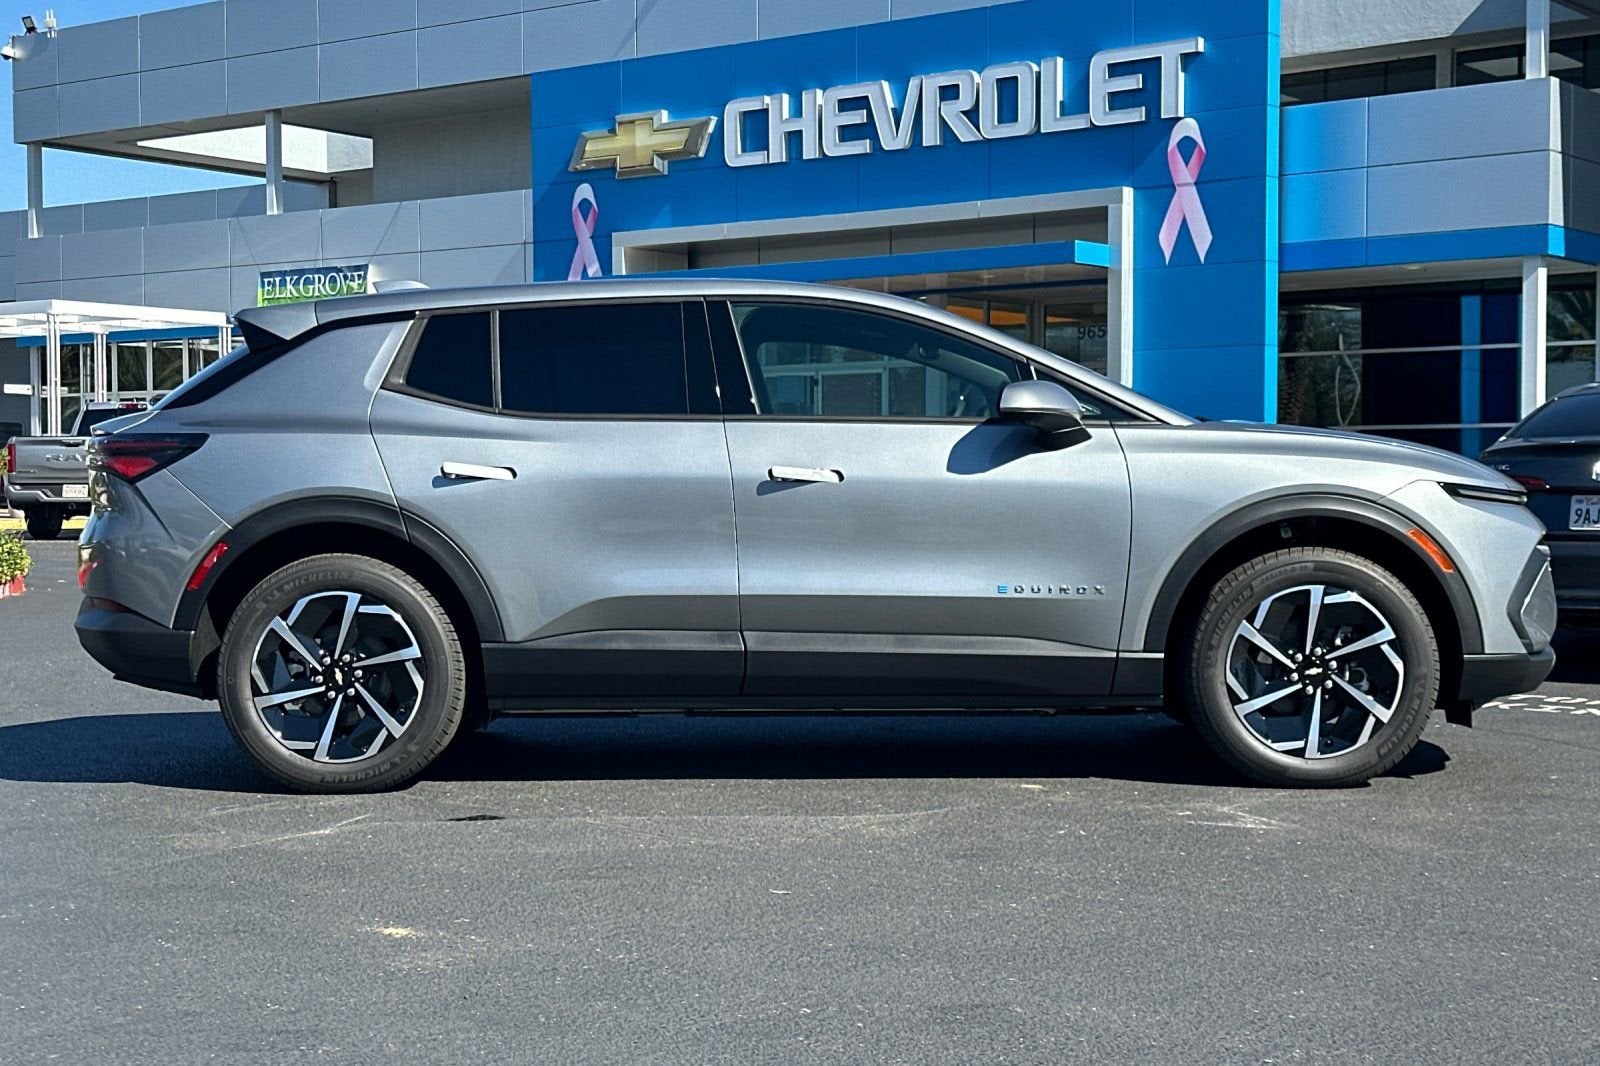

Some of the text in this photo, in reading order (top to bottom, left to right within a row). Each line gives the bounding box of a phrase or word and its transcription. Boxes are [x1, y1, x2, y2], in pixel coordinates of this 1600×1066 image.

[723, 36, 1204, 168] CHEVROLET
[282, 571, 348, 594] MICHELIN
[997, 584, 1105, 595] EQUINOX
[1210, 588, 1251, 648] MICHELIN
